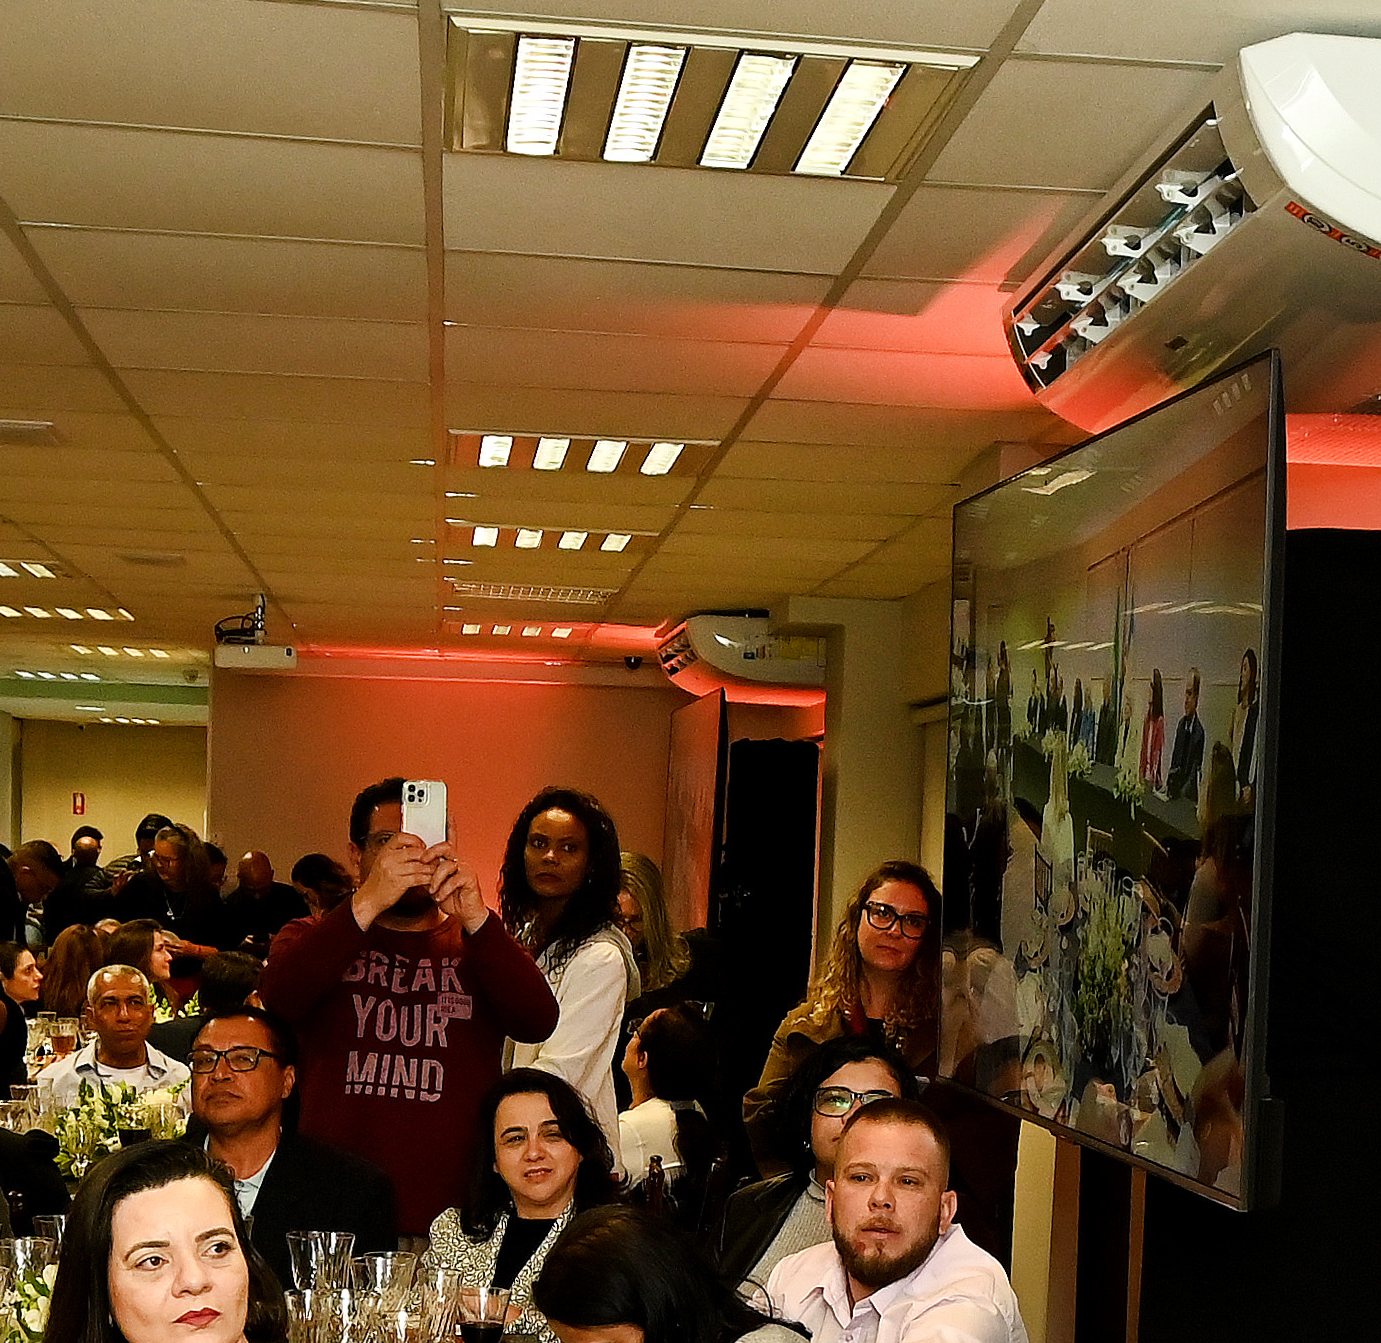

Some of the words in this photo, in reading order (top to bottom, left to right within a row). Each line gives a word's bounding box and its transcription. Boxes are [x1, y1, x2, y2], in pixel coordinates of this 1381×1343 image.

[342, 950, 465, 995] BREAK
[352, 993, 449, 1048] YOUR
[344, 1050, 445, 1103] MIND
